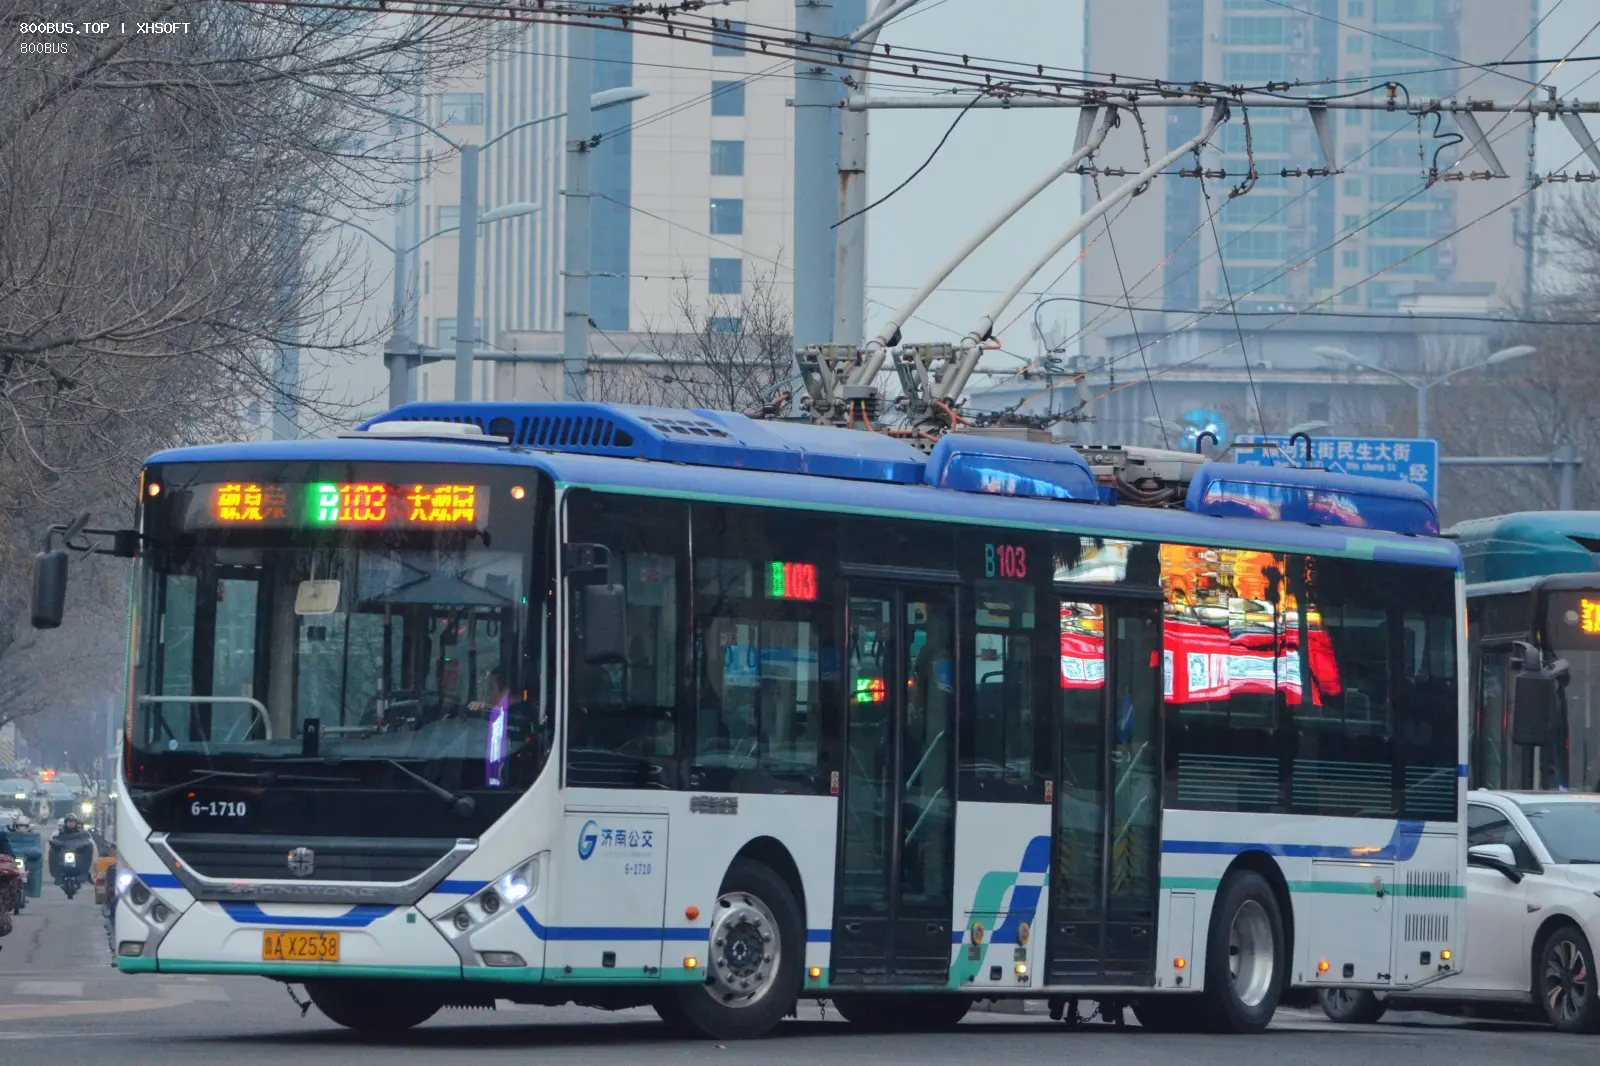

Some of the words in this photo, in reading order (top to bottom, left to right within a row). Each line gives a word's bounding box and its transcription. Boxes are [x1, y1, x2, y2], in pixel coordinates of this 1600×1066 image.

[191, 801, 246, 817] 6-1710
[600, 828, 653, 848] 济南公交
[624, 863, 652, 876] 6-1710
